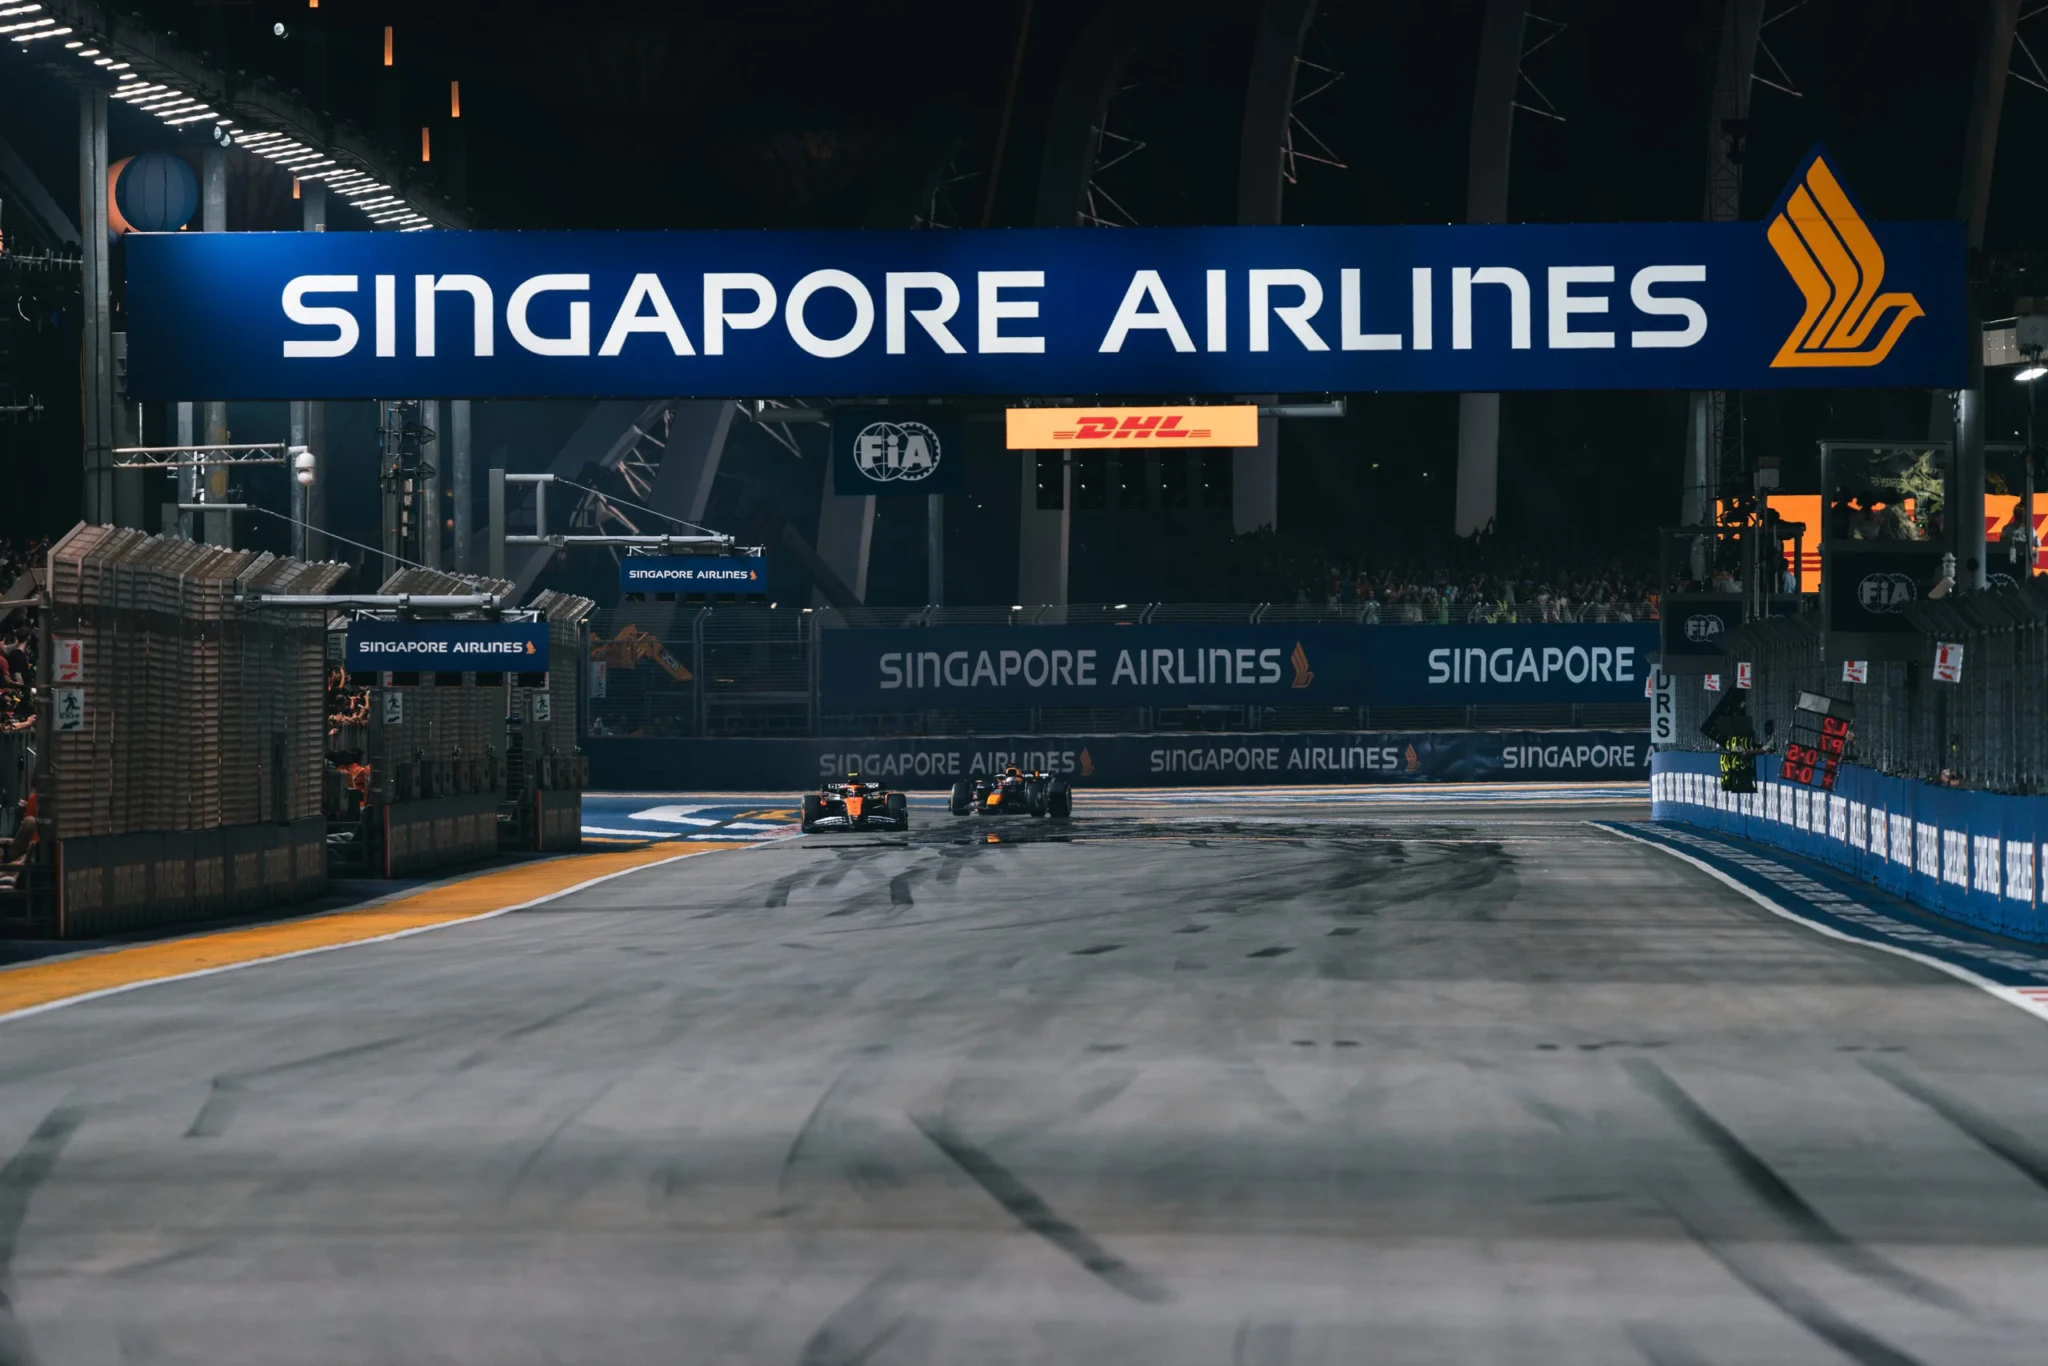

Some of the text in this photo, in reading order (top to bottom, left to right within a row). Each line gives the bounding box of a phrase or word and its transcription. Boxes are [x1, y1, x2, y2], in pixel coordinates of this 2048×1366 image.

[281, 265, 1708, 359] SINGAPORE AIRLINES
[1075, 415, 1191, 439] DHL
[629, 570, 748, 580] SINGAPORE AIRLINES
[359, 641, 523, 653] SINGAPORE AIRLINES
[879, 647, 1282, 689] SINGAPORE AIRLINES
[1427, 645, 1635, 684] SINGAPORE
[1656, 669, 1671, 738] DRS
[819, 752, 960, 777] SINGAPORE
[1150, 746, 1399, 773] SINGAPORE AIRLINES
[1502, 745, 1635, 769] SINGAPORE
